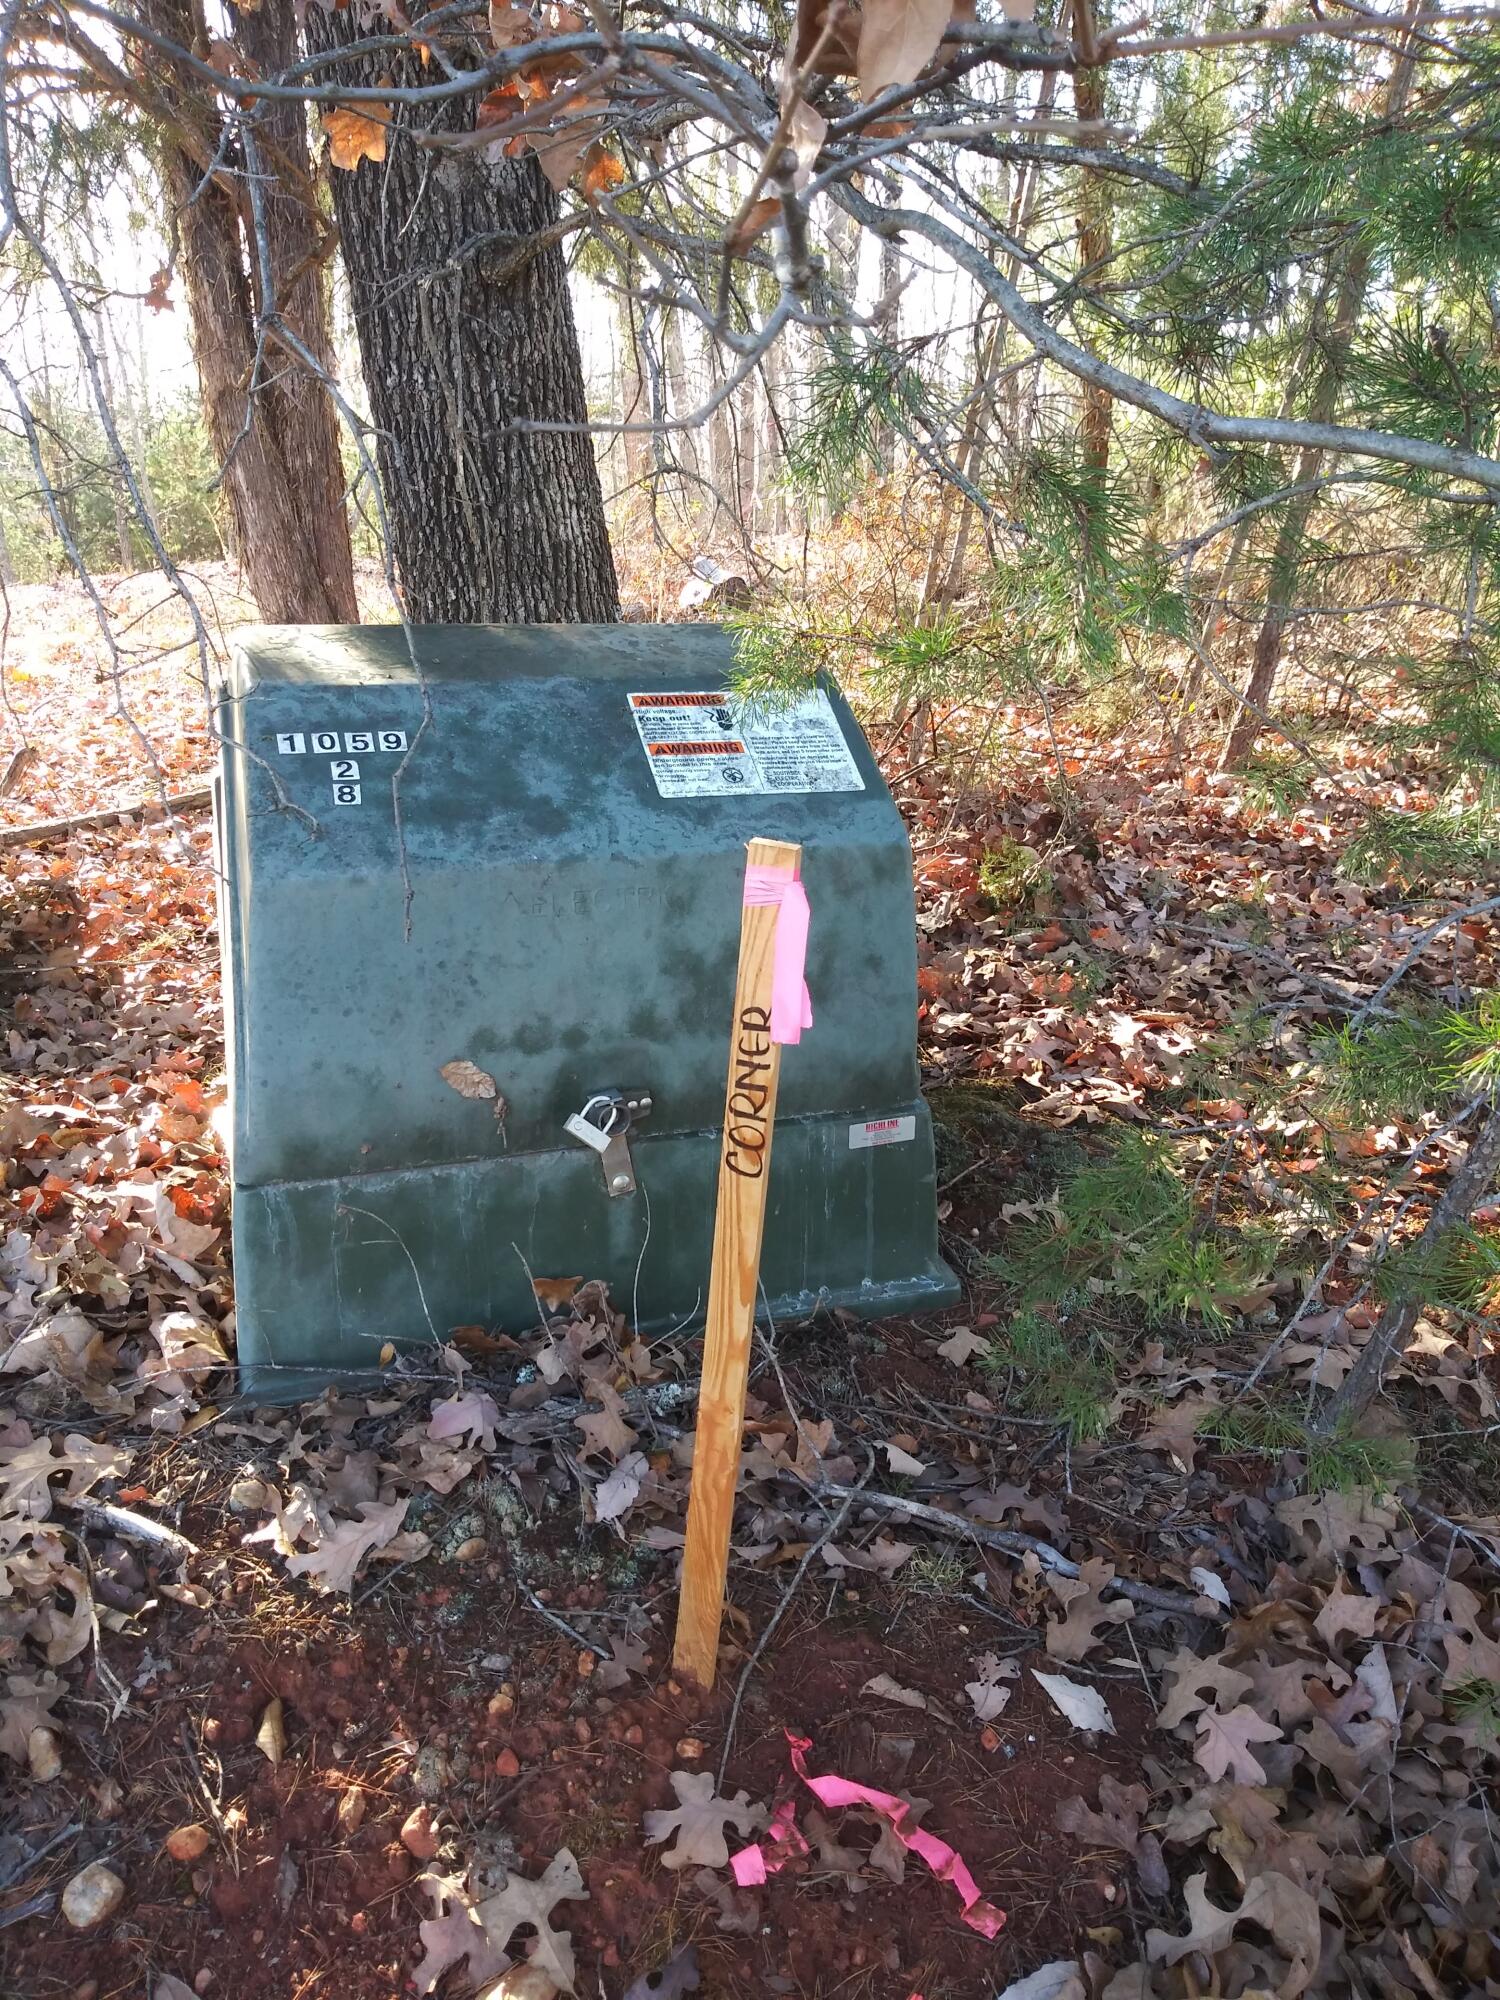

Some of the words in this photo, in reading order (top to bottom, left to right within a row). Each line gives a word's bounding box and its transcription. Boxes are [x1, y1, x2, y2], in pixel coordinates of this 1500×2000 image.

[648, 694, 722, 706] WARNING
[638, 715, 666, 723] Keep
[666, 742, 739, 754] WARNING
[336, 761, 354, 778] 2
[338, 785, 356, 803] 8
[725, 1006, 772, 1178] CORNER
